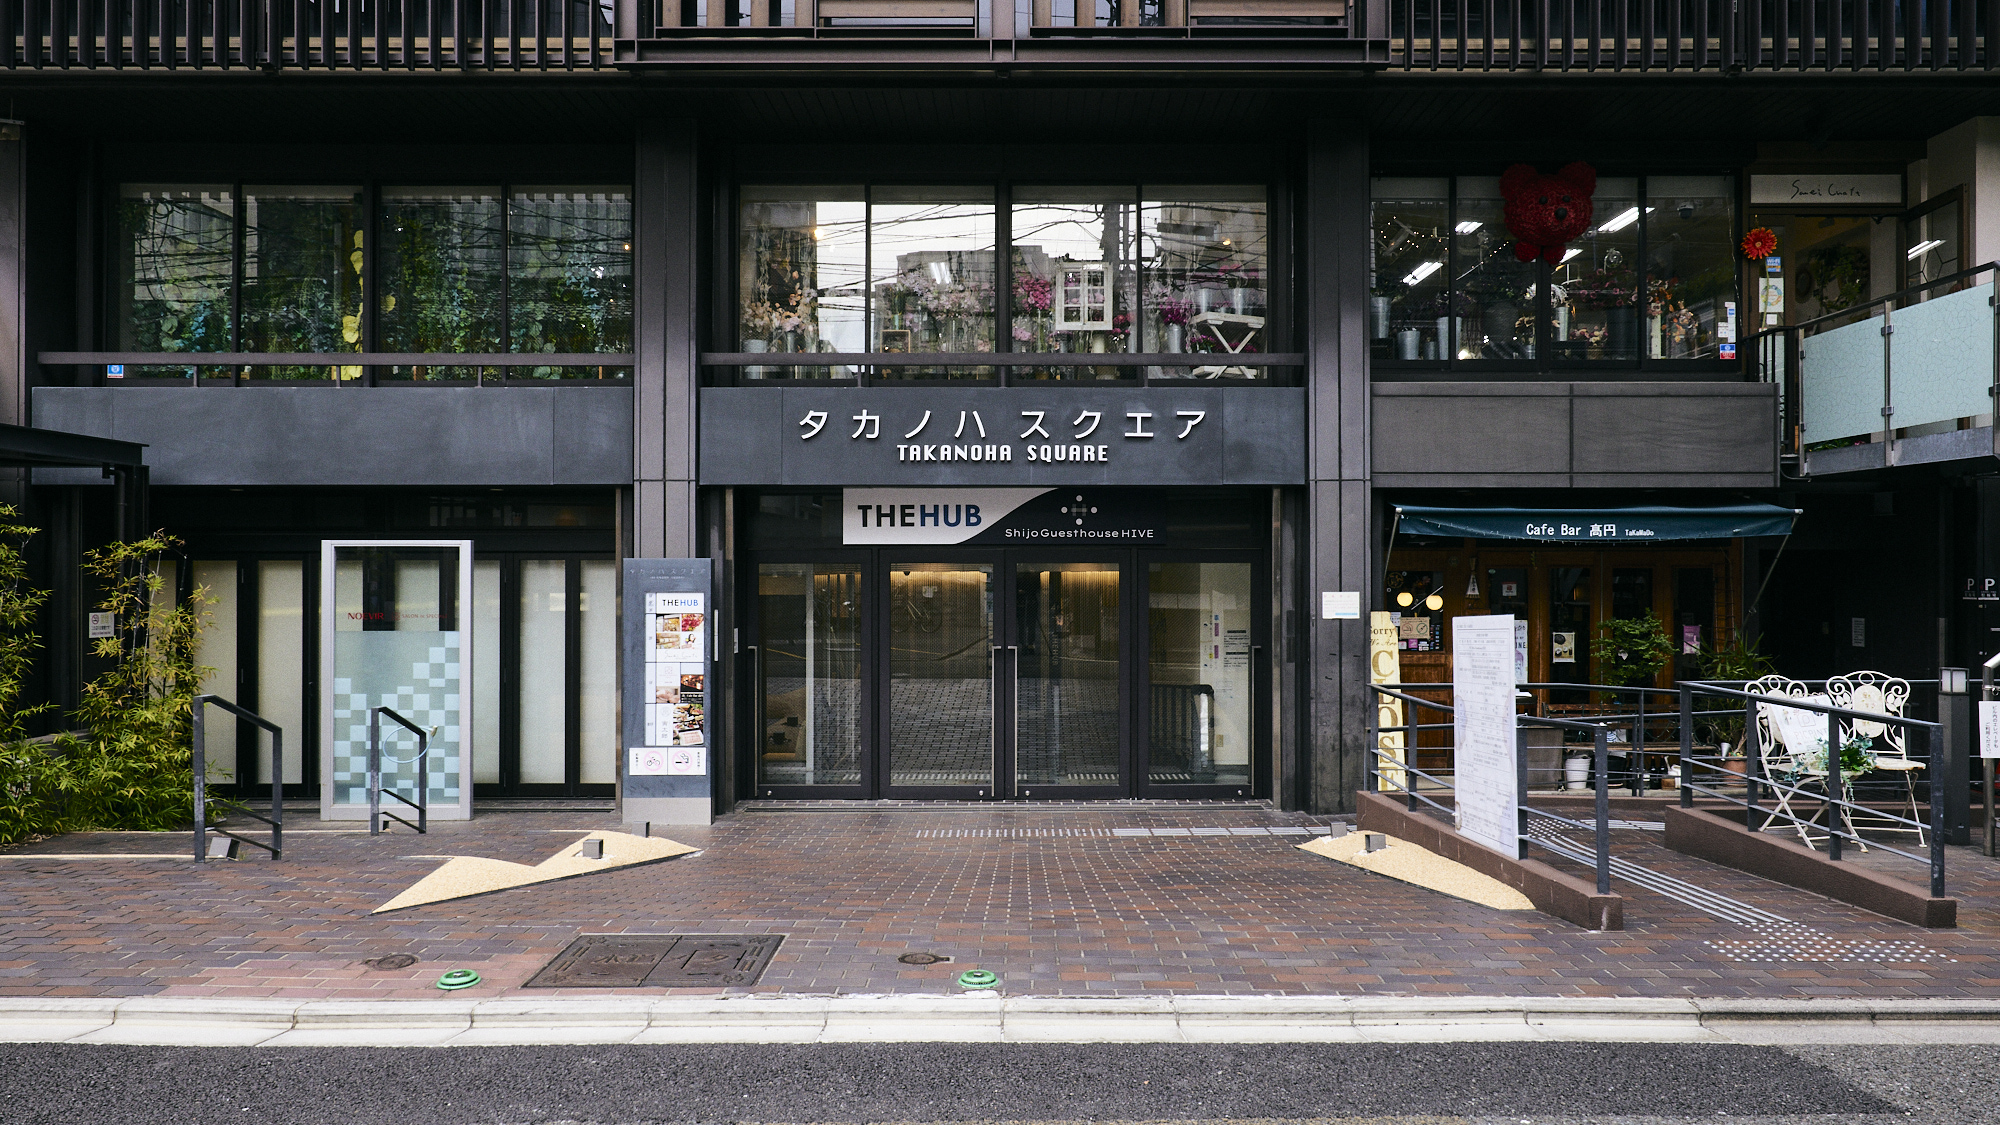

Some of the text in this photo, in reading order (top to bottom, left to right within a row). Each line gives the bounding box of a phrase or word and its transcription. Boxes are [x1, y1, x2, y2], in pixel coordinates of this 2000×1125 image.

[897, 444, 1109, 462] TAKANOHA SQUARE
[1526, 523, 1555, 536] Cafe
[1560, 523, 1582, 536] Bar
[1984, 578, 1996, 591] P
[347, 612, 384, 620] NOEVIR
[1370, 626, 1395, 638] orry
